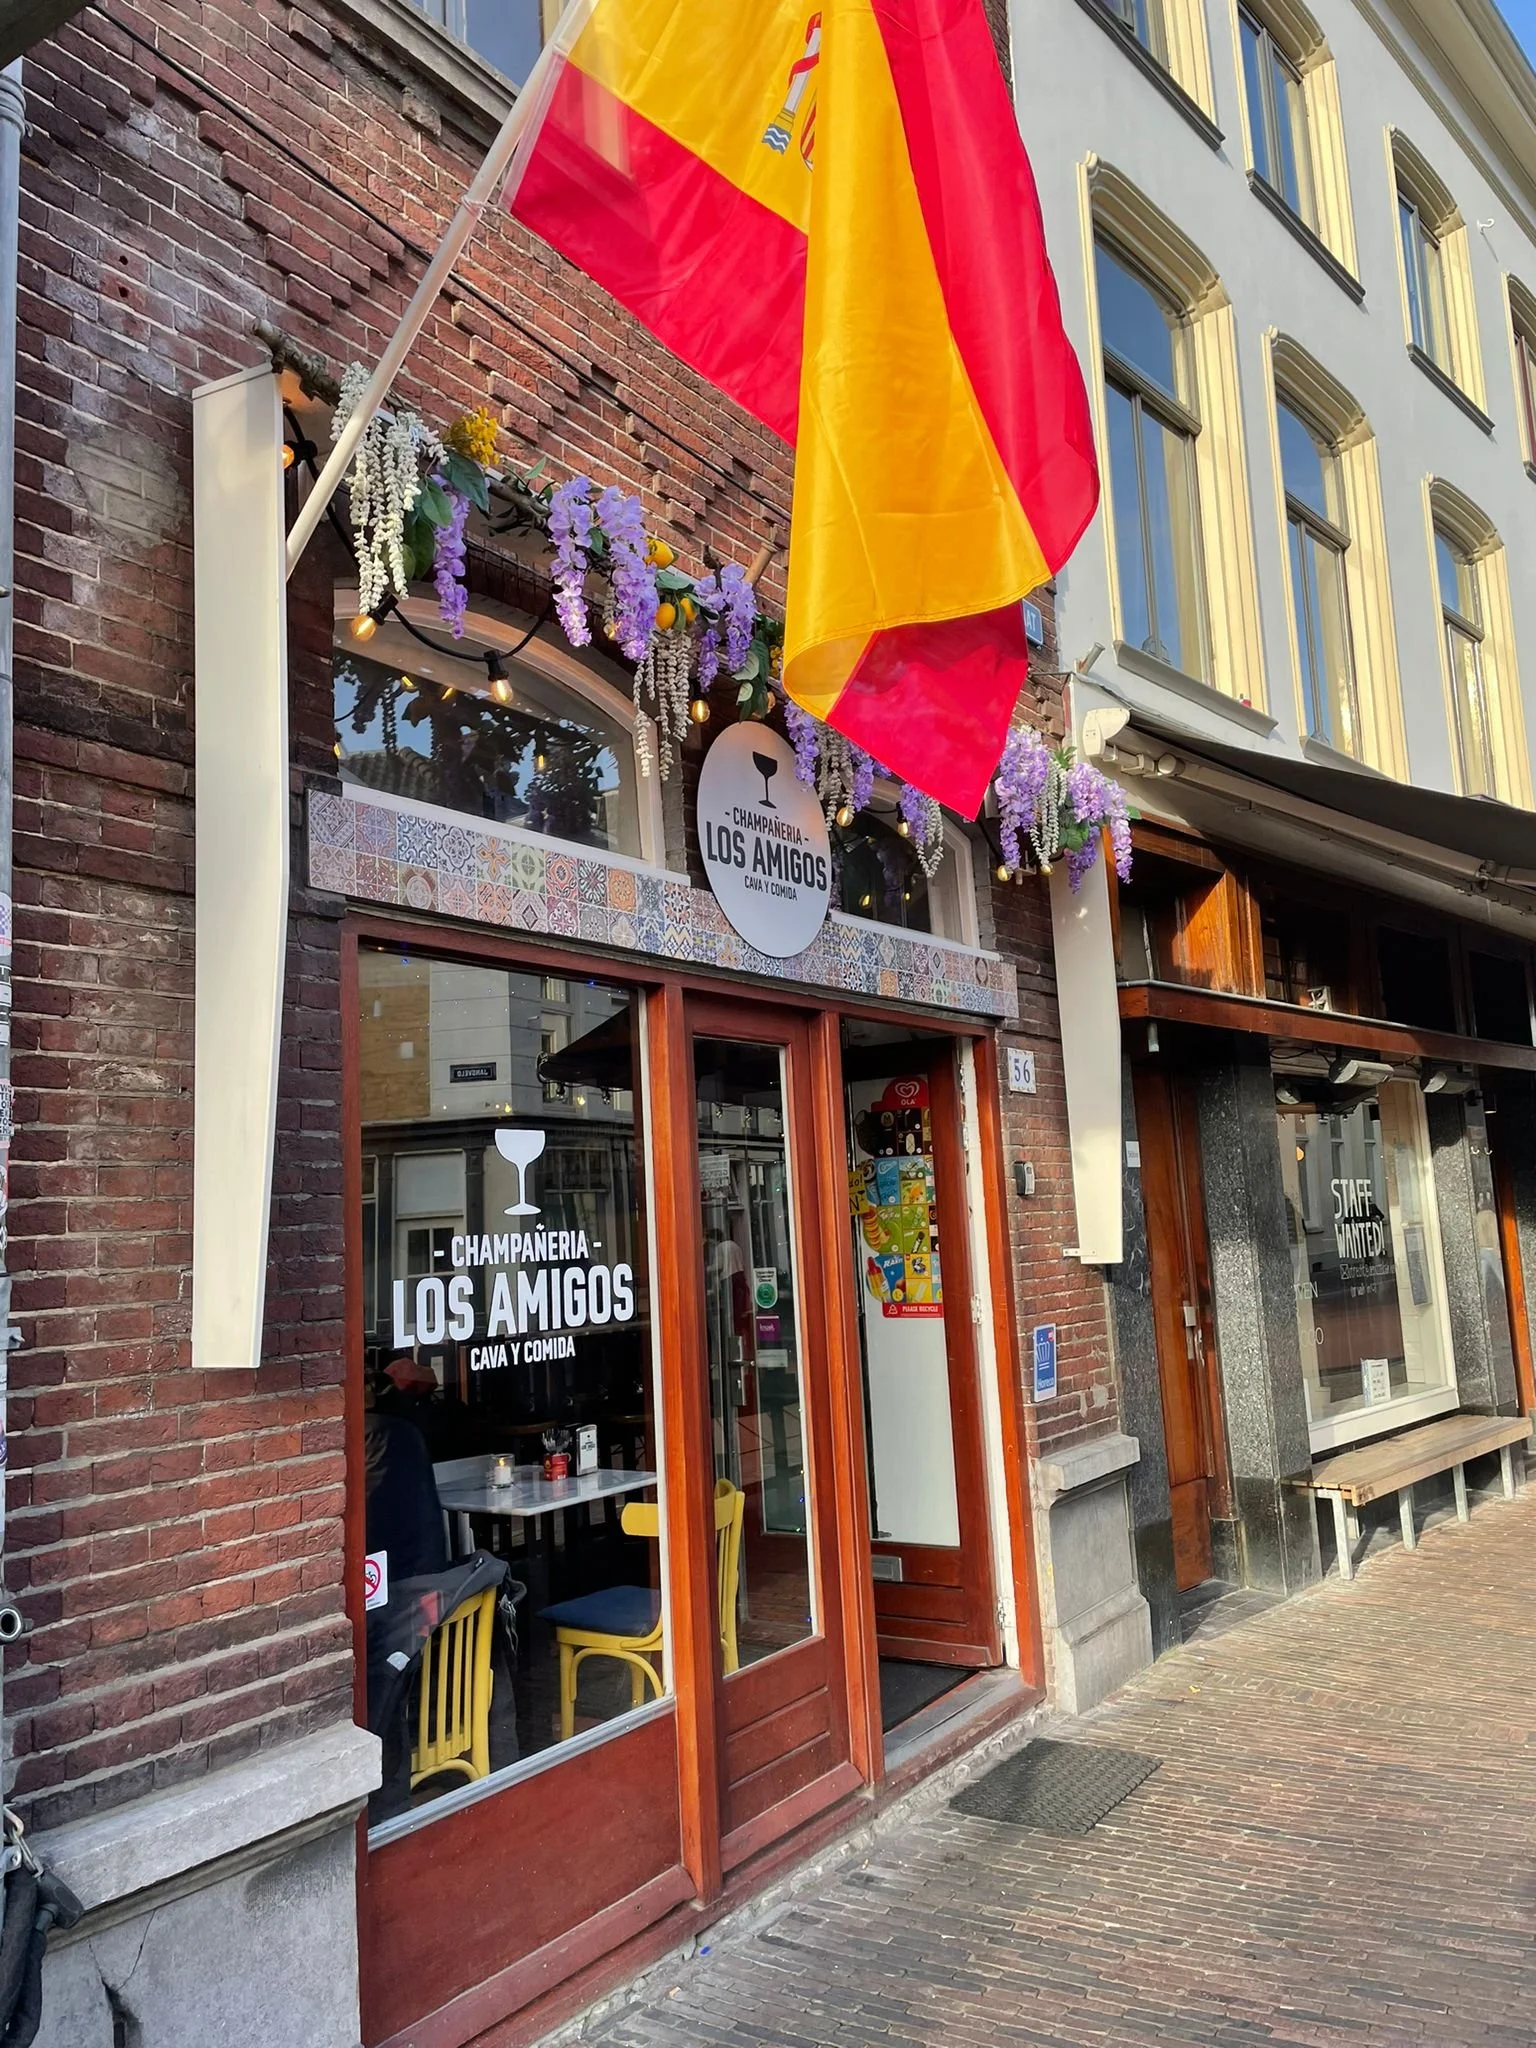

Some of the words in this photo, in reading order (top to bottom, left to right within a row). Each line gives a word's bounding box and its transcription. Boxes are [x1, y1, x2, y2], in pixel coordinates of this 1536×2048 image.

[733, 807, 802, 846] CHAMPAÑERIA
[706, 821, 746, 869] LOS
[752, 837, 827, 891] AMIGOS
[744, 875, 763, 893] CAVA
[764, 881, 770, 894] Y
[771, 882, 798, 901] COMIDA
[1014, 1058, 1031, 1084] 56
[1331, 1178, 1373, 1220] STAFF
[451, 1223, 589, 1267] CHAMPAÑERIA
[1334, 1221, 1386, 1259] WANTED!
[392, 1276, 475, 1350] LOS
[487, 1263, 634, 1338] AMIGOS
[470, 1345, 508, 1372] CAVA
[511, 1344, 521, 1366] Y
[523, 1336, 576, 1364] COMIDA
